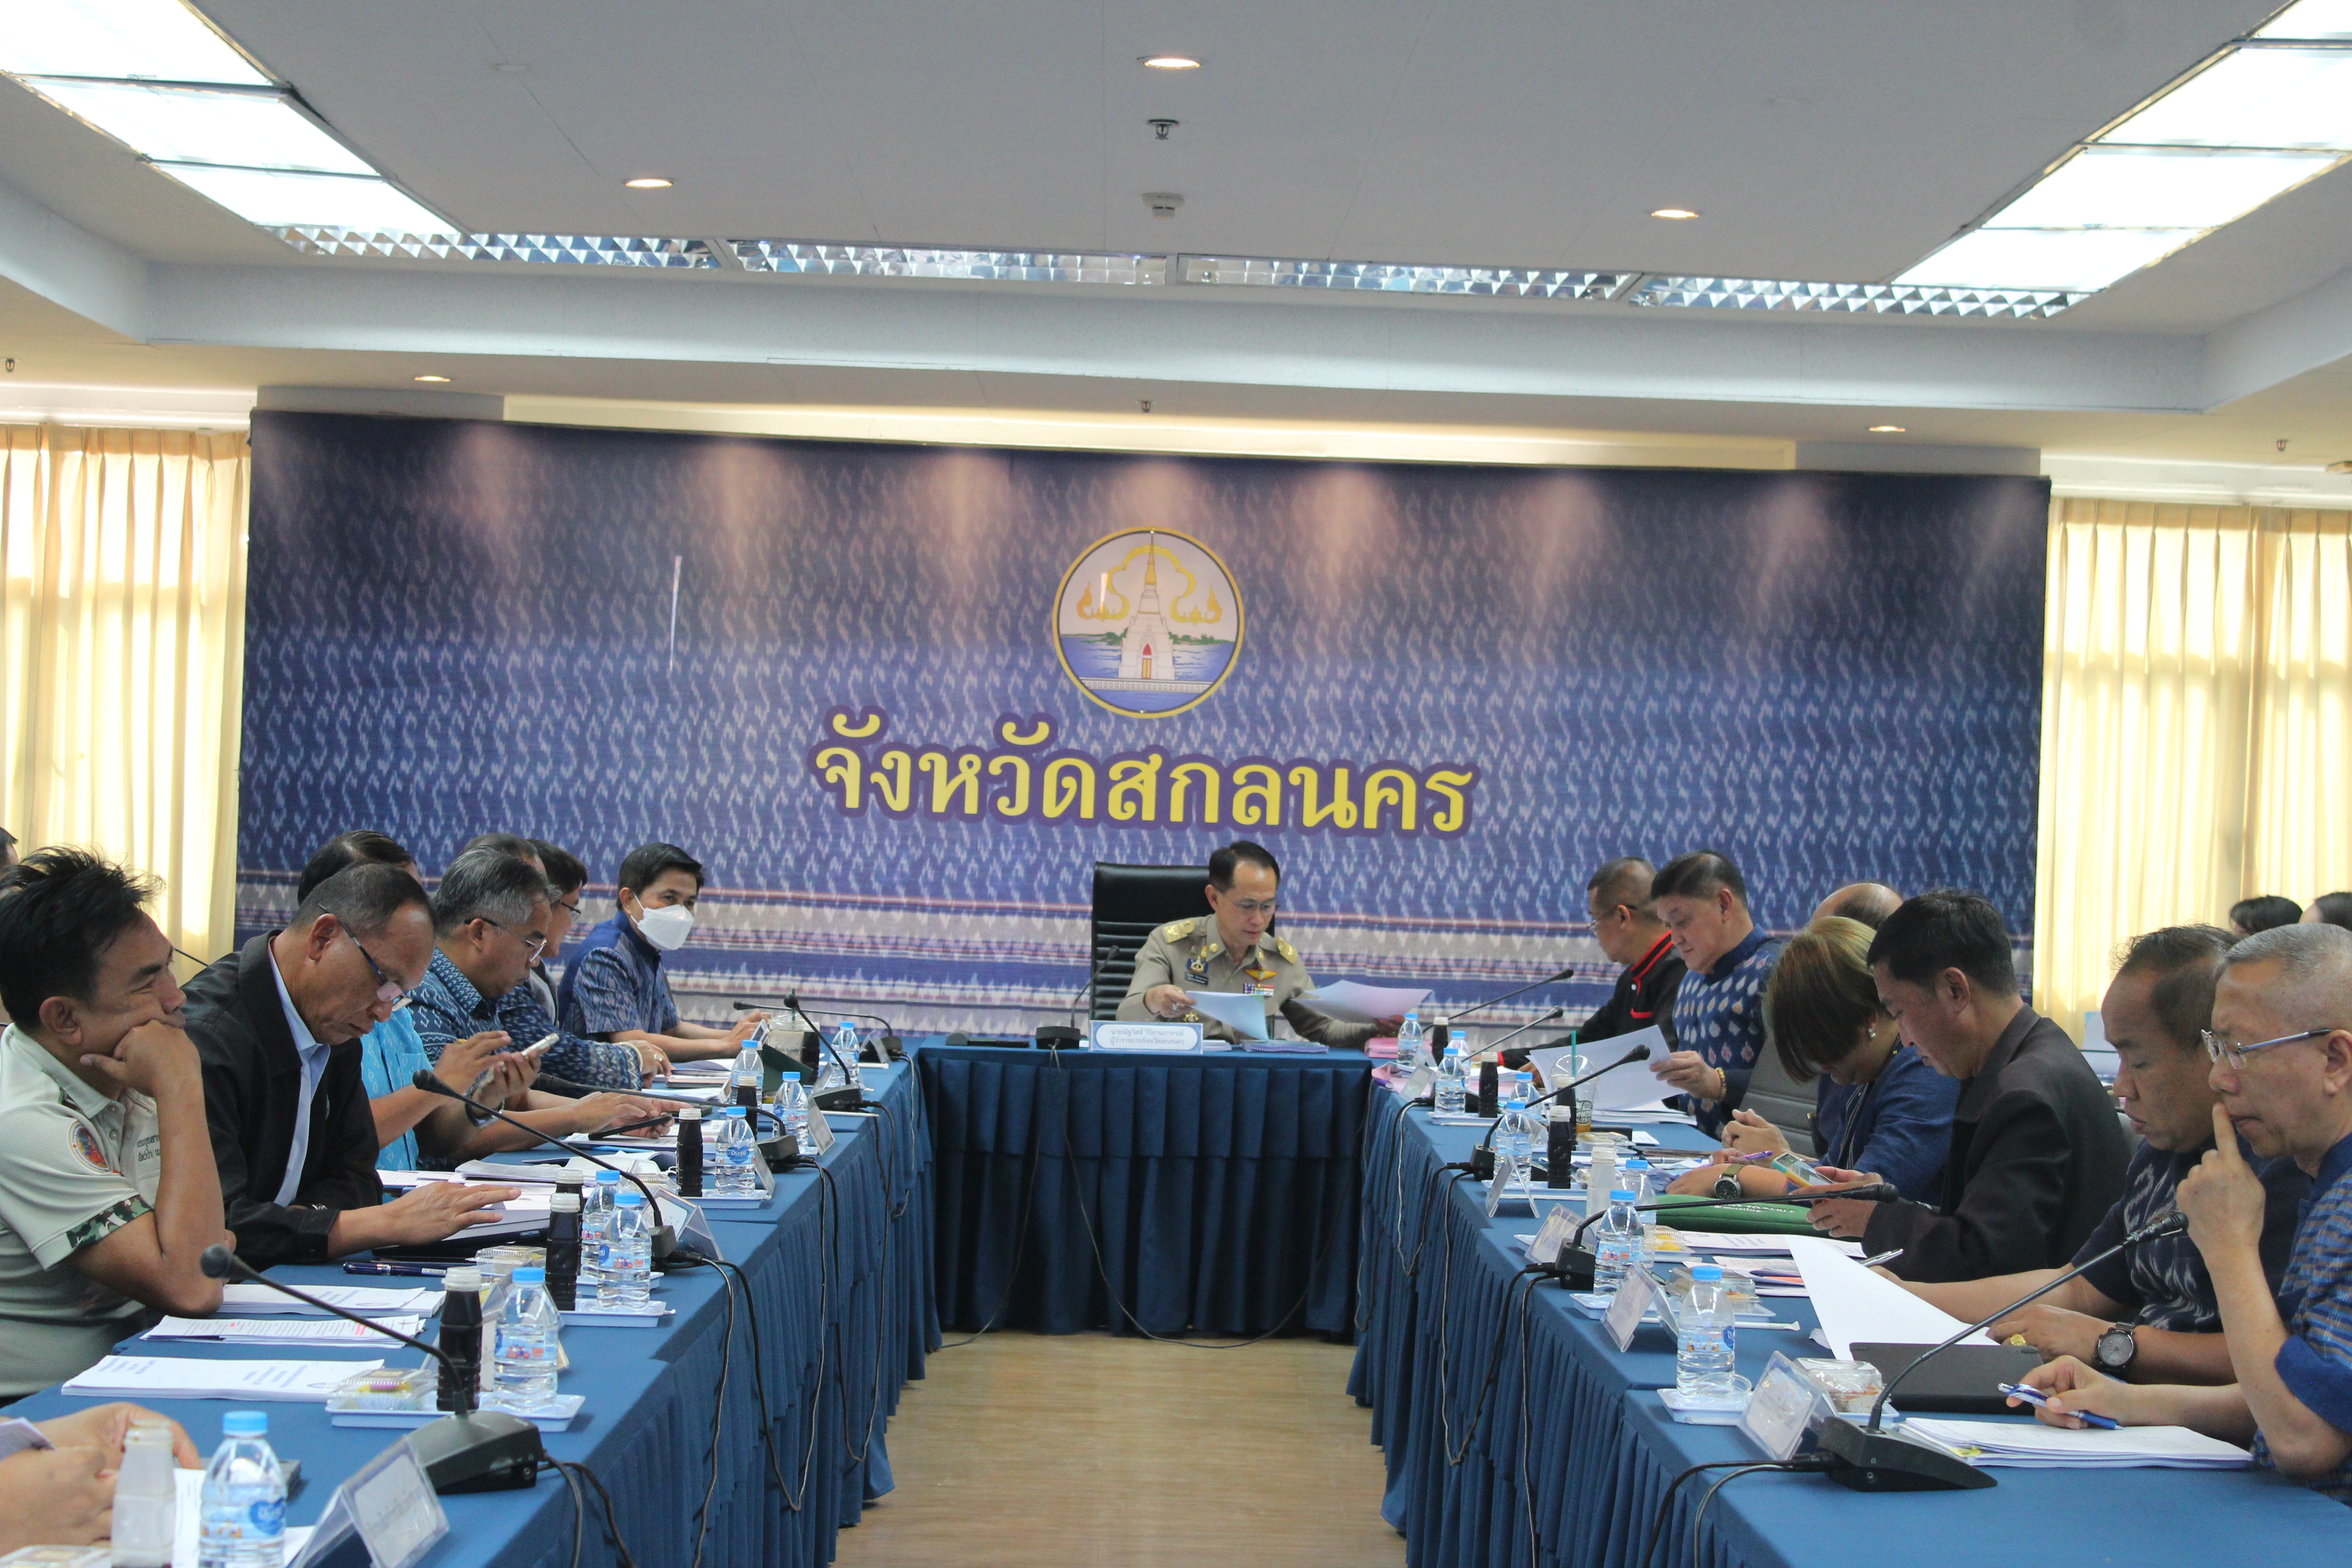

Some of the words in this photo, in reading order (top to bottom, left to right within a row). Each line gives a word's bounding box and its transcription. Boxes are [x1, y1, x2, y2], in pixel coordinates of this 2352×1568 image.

[815, 714, 1473, 832] จังหวัดสกลนคร
